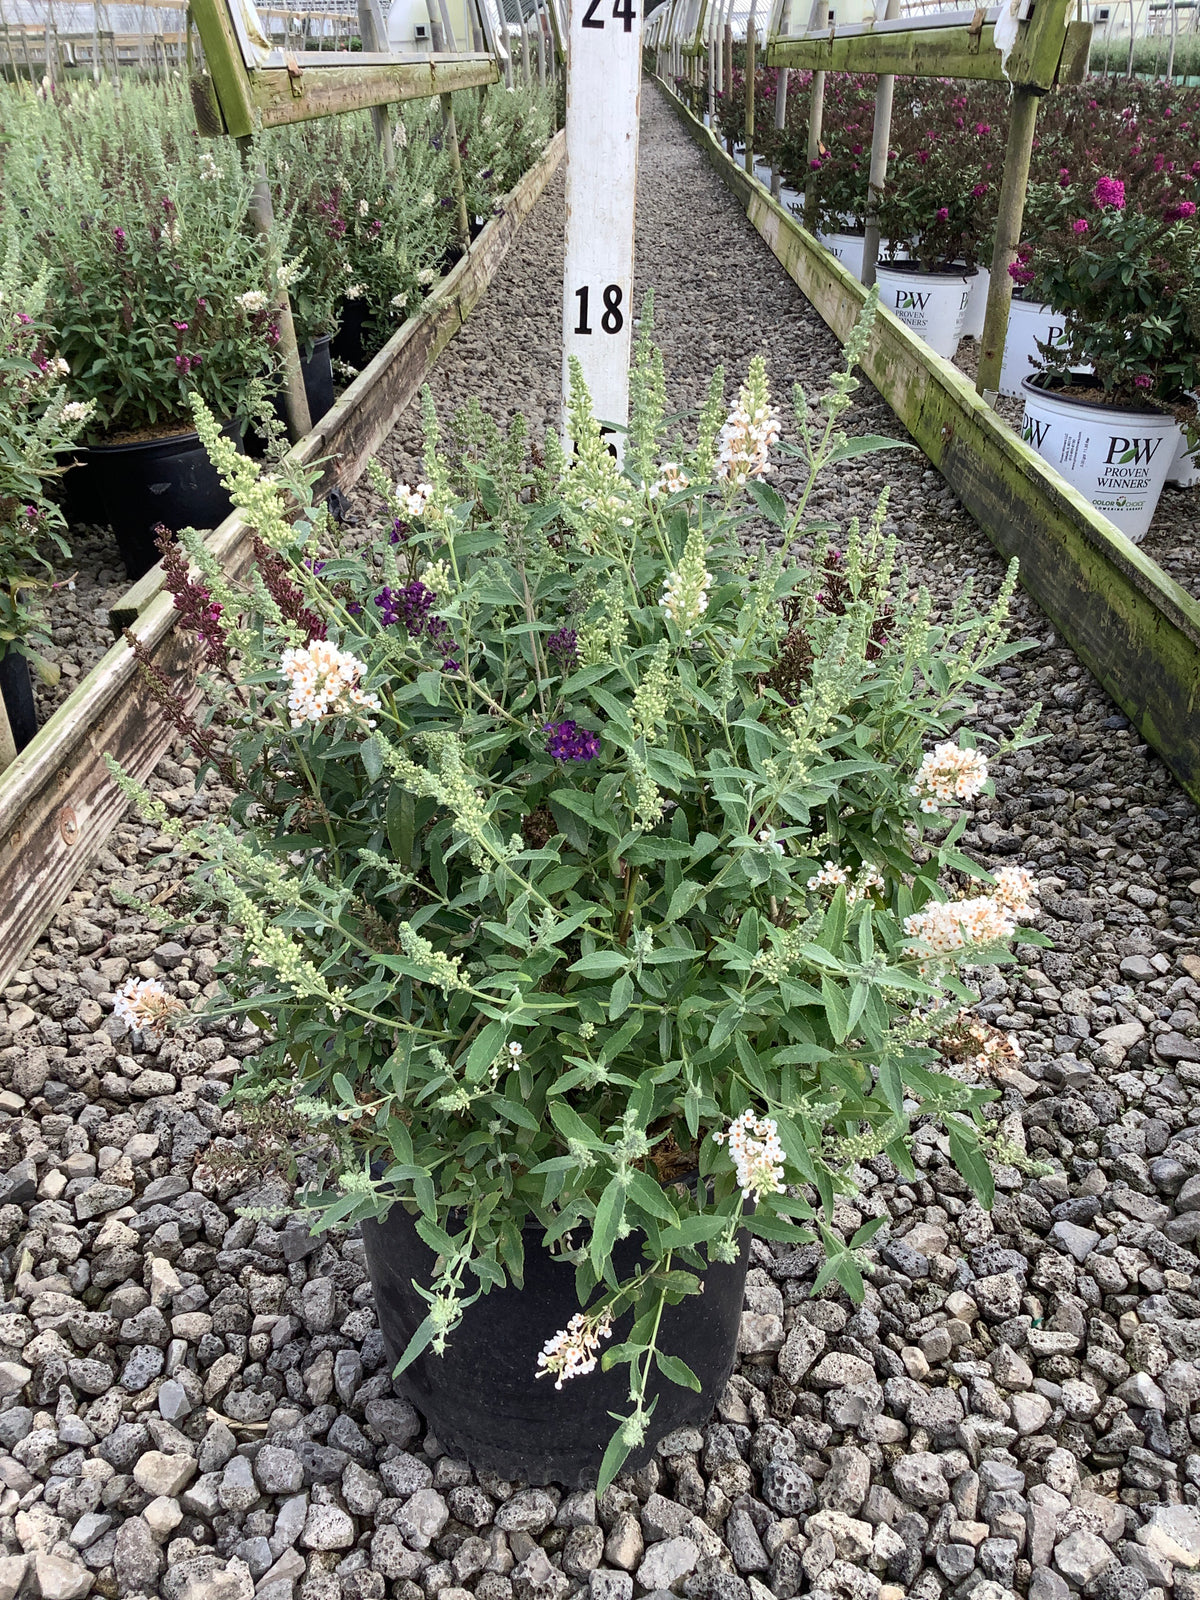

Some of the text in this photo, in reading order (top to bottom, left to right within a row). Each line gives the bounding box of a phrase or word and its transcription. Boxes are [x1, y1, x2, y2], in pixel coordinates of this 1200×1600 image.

[581, 0, 636, 33] 24
[574, 284, 623, 335] 18
[895, 290, 932, 310] PW
[895, 310, 925, 318] PROVEN
[1102, 436, 1164, 466] PW
[1104, 467, 1150, 478] PROVEN
